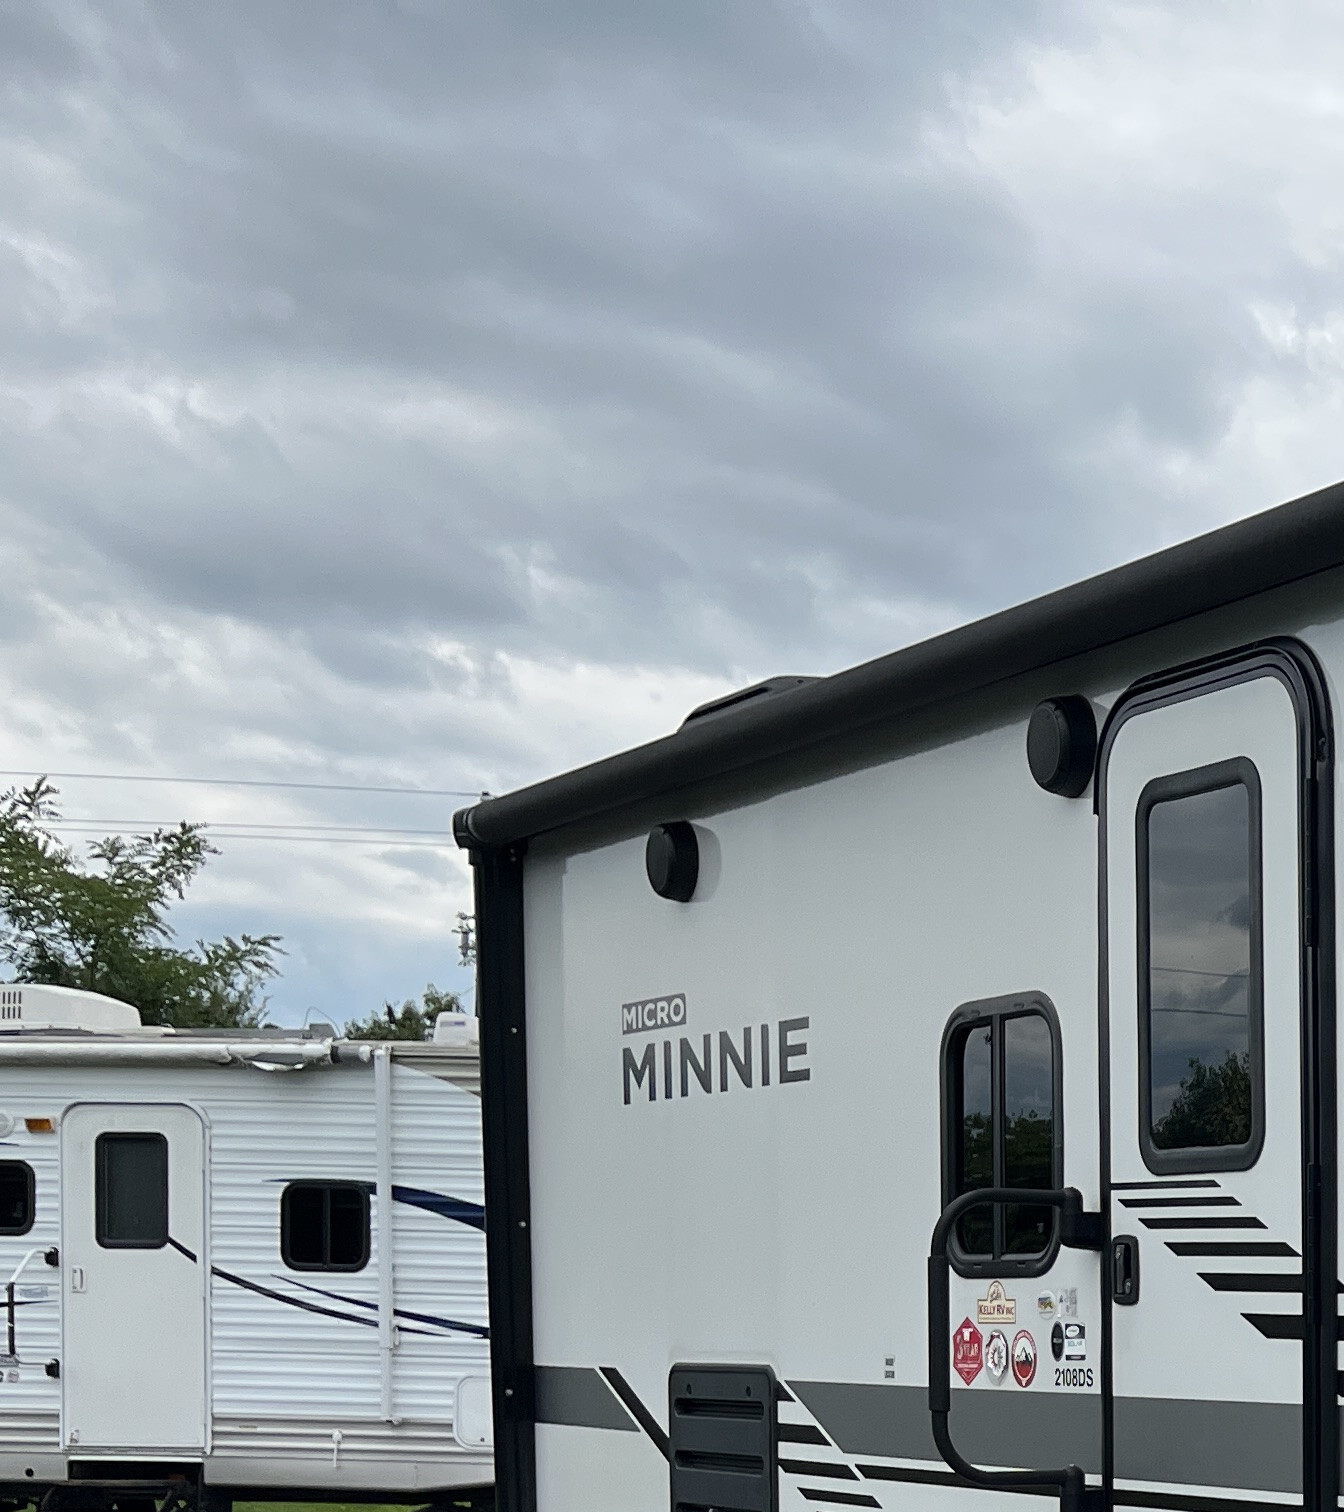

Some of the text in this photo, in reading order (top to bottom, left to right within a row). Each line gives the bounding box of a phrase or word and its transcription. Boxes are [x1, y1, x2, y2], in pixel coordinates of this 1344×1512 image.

[622, 996, 686, 1032] MICRO
[623, 1016, 810, 1105] MINNIE
[979, 1304, 995, 1315] KELLY
[997, 1304, 1006, 1315] RV
[1054, 1368, 1094, 1388] 2108DS
